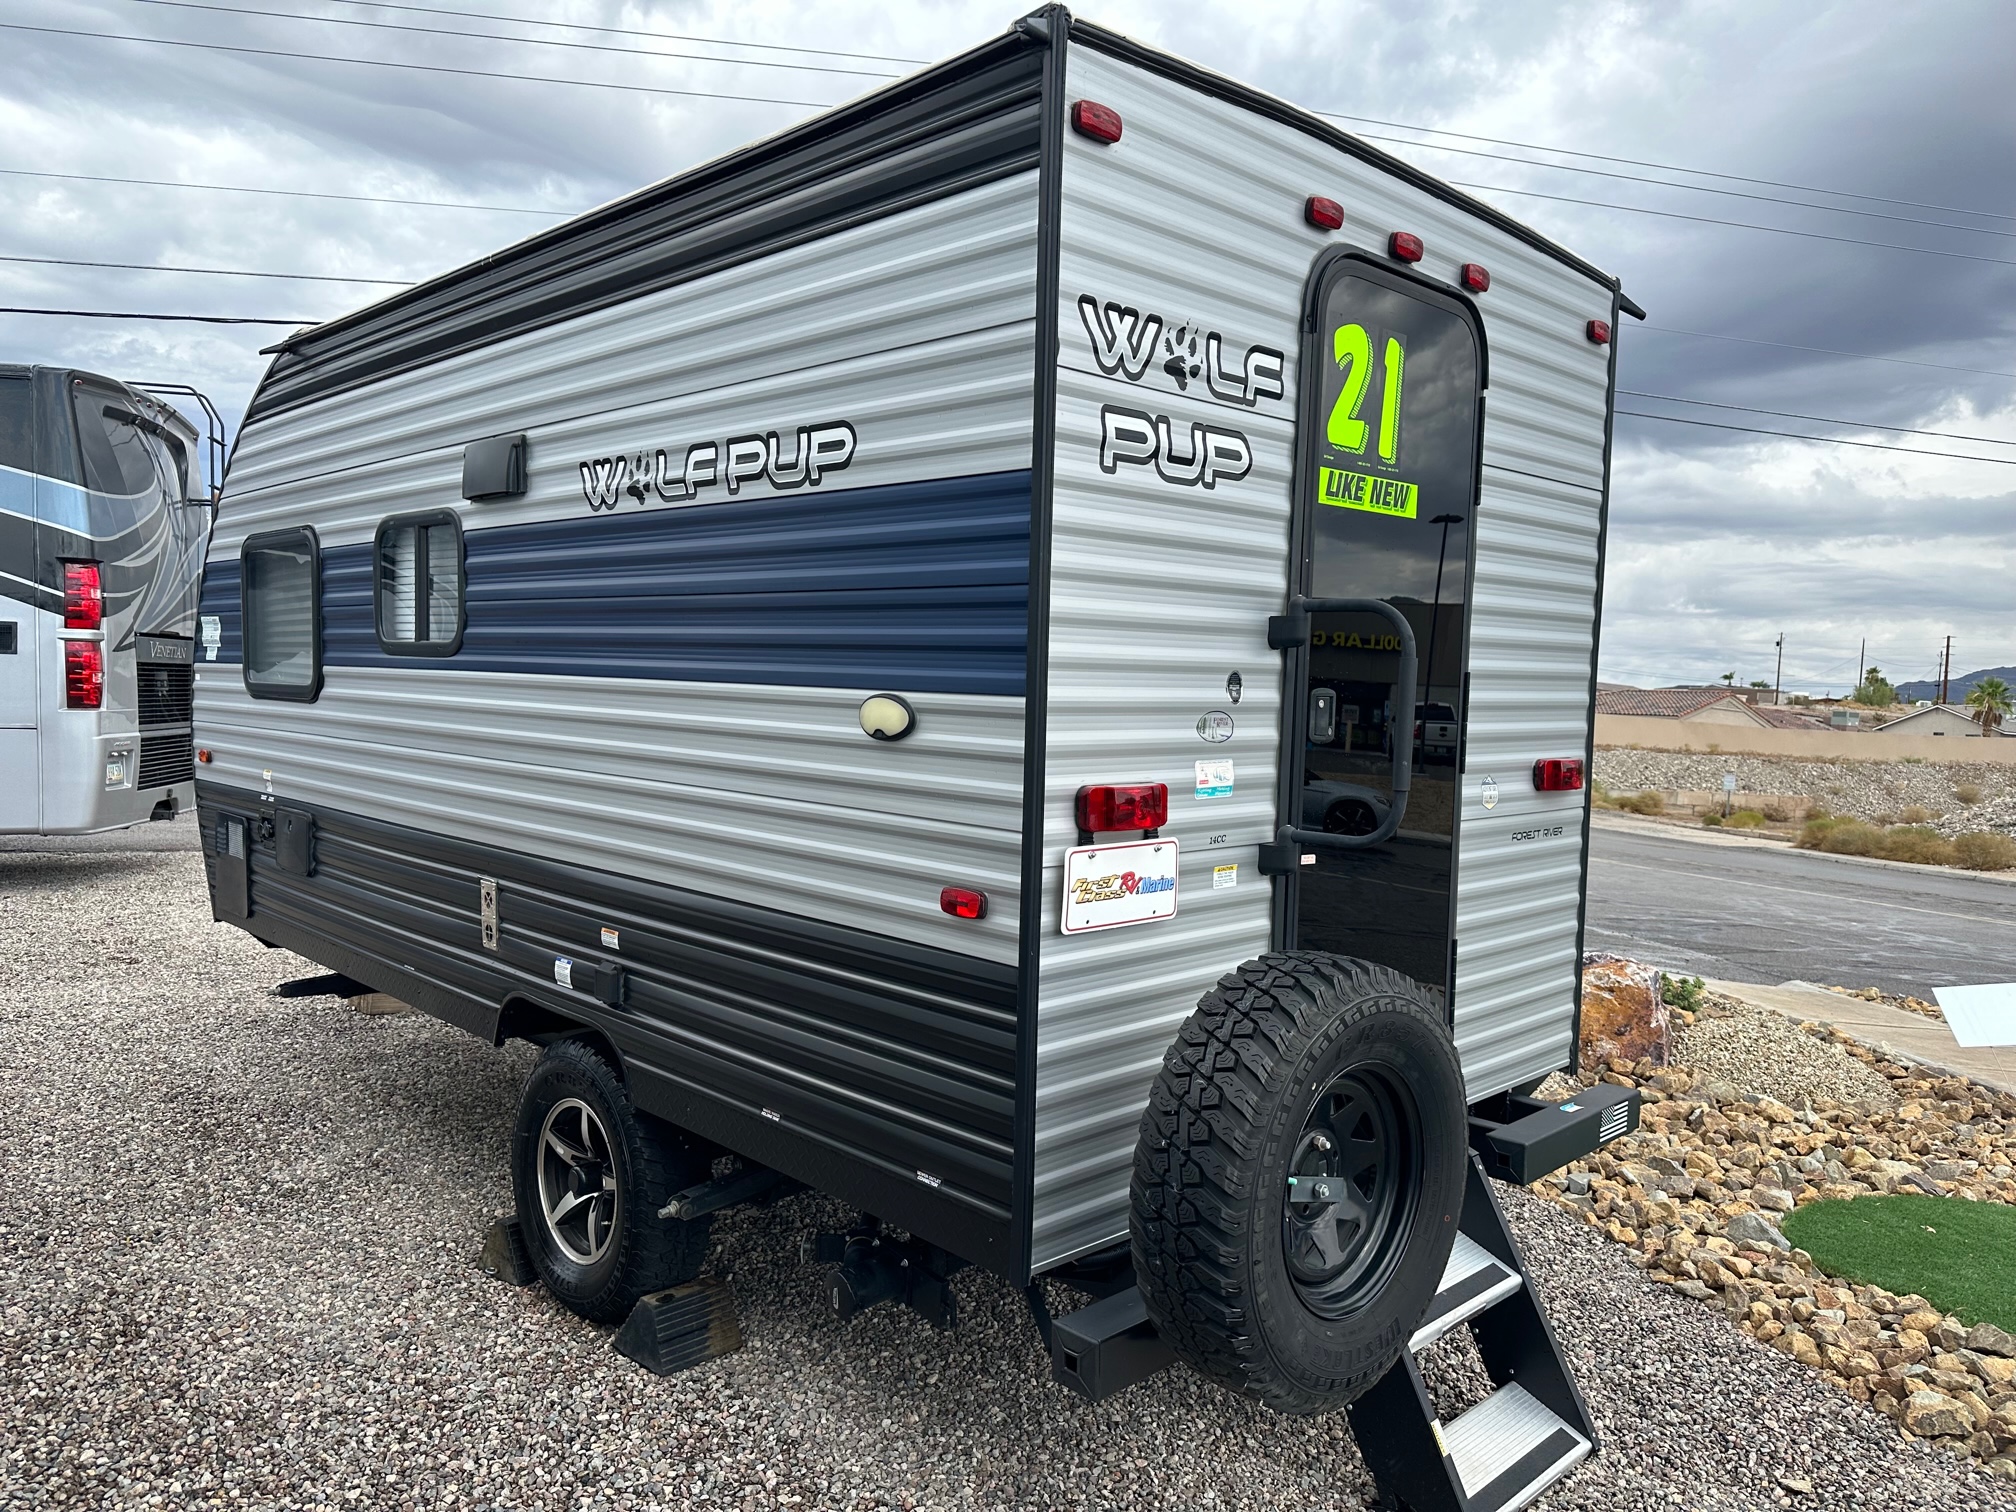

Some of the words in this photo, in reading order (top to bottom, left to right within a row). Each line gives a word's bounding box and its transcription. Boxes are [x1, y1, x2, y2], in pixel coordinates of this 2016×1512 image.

[1327, 323, 1404, 464] 21
[1100, 404, 1253, 489] PUP
[726, 420, 857, 495] PUP
[1326, 470, 1368, 506] LIKE
[1370, 478, 1412, 513] NEW
[150, 641, 187, 659] VENETIAN
[1209, 834, 1227, 845] 14CC
[1511, 829, 1541, 841] FOREST
[1543, 826, 1563, 838] RIVER
[1071, 874, 1121, 893] First
[1119, 871, 1143, 895] RV
[1140, 875, 1175, 895] Marine
[1075, 888, 1127, 905] Class
